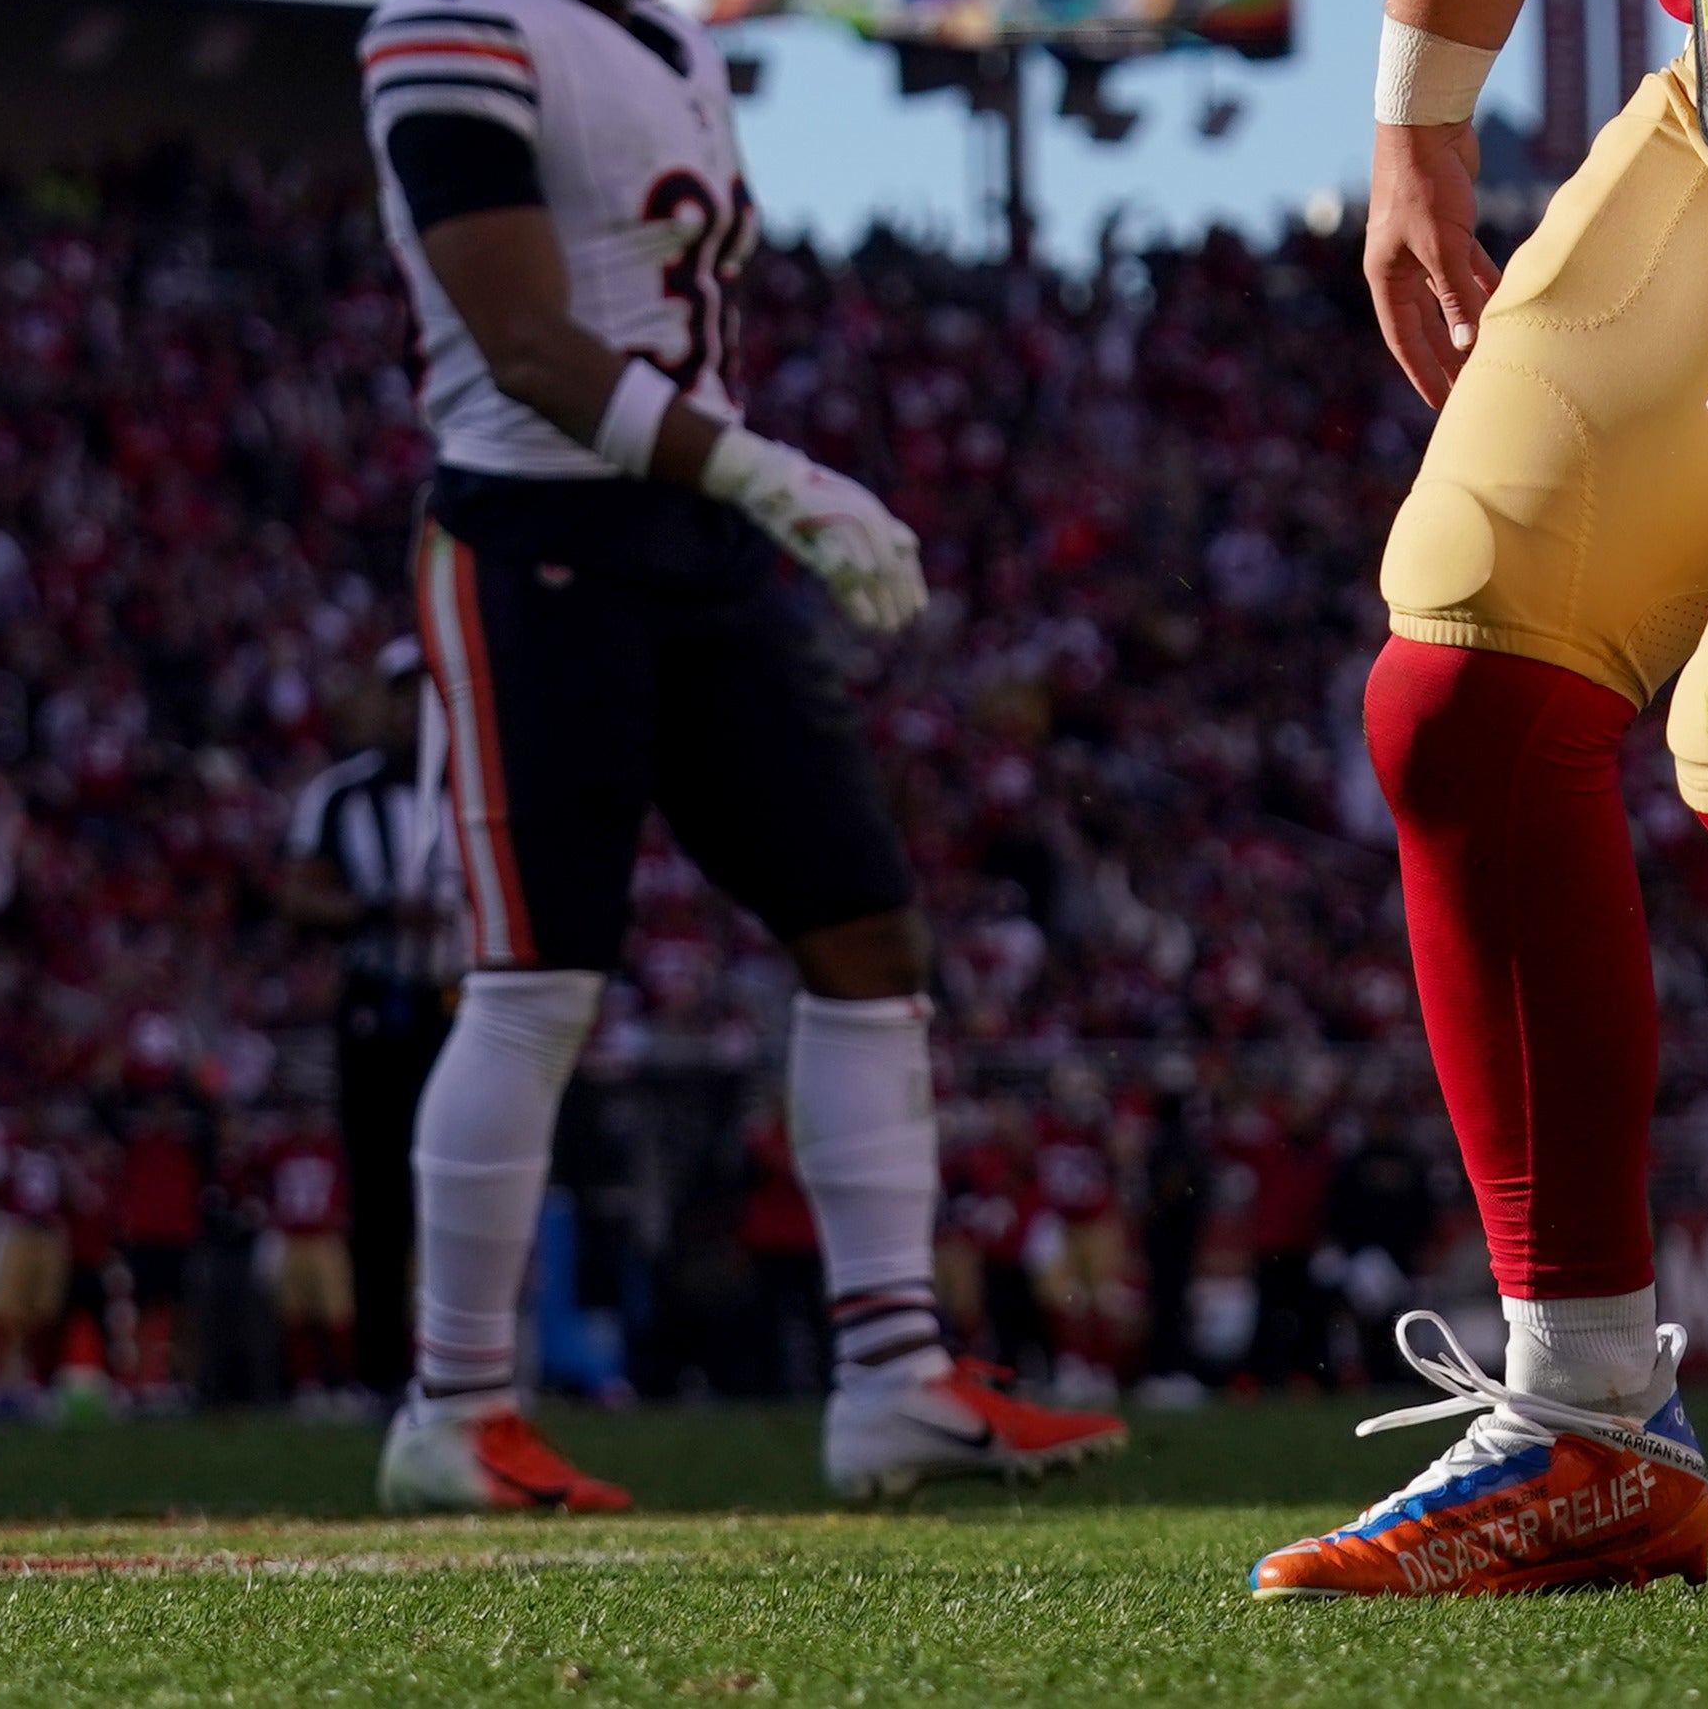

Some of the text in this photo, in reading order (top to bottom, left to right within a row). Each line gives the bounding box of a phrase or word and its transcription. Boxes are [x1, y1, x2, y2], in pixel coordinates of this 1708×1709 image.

[1396, 1506, 1543, 1592] DISASTER
[1549, 1461, 1657, 1544] RELIEF
[1493, 1484, 1549, 1515] HELENE
